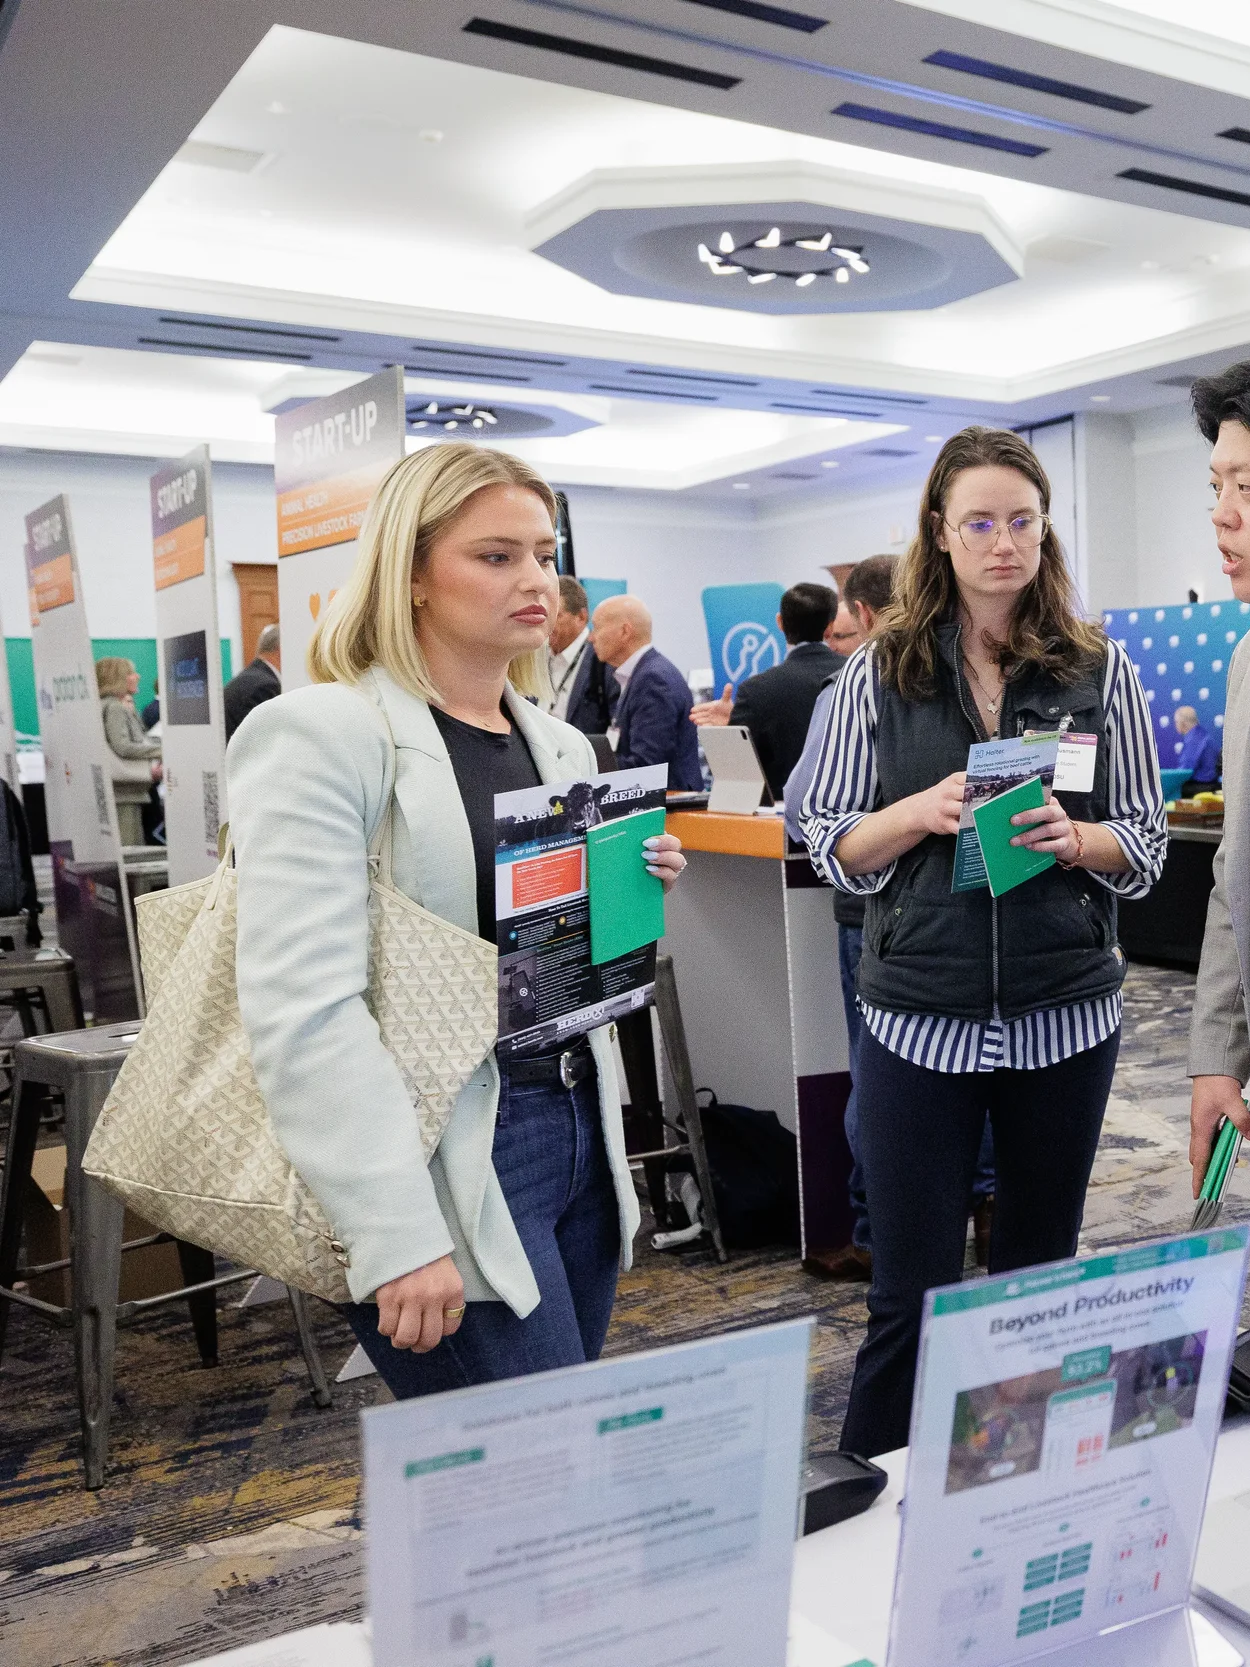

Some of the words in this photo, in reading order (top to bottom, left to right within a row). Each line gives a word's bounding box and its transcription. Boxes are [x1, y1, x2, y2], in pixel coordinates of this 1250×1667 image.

[292, 400, 378, 467] START-UP
[600, 788, 647, 805] BREED
[513, 848, 525, 857] OF
[525, 844, 547, 856] HERD
[988, 1302, 1068, 1337] Beyond
[1073, 1274, 1196, 1315] Productivity
